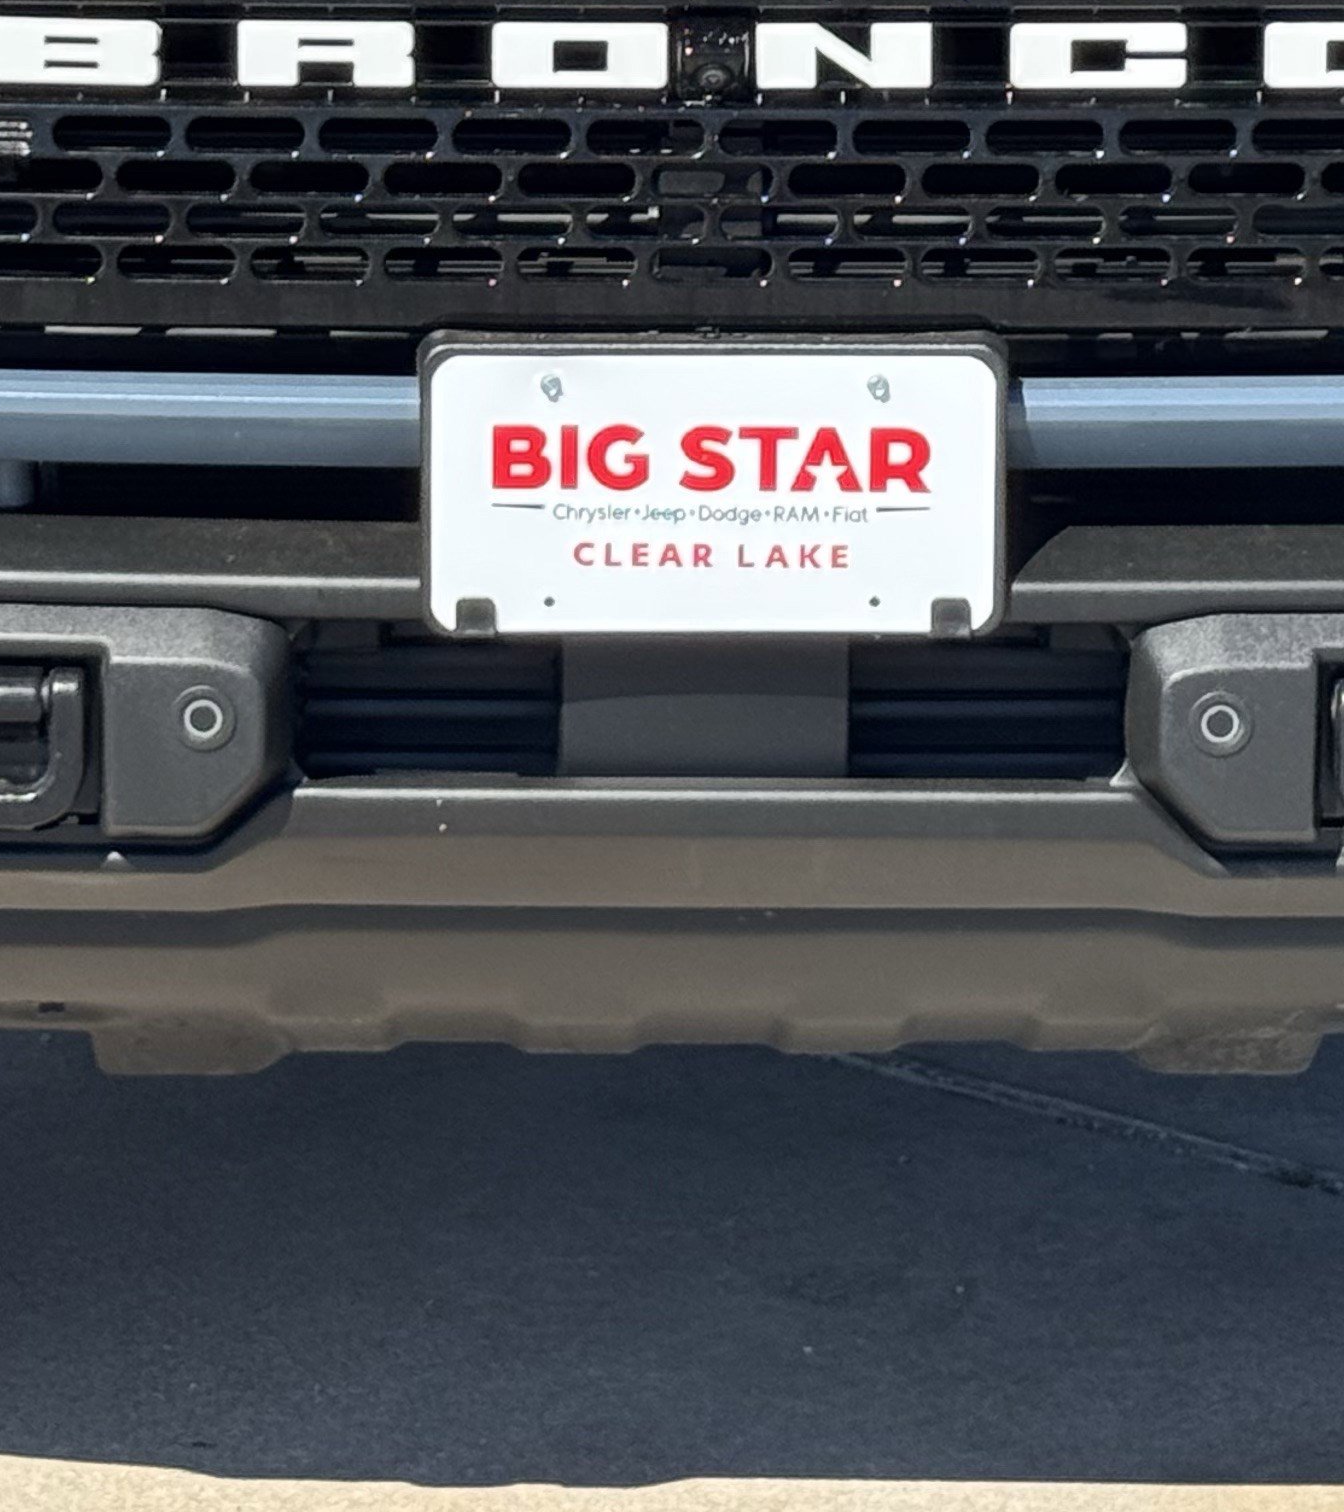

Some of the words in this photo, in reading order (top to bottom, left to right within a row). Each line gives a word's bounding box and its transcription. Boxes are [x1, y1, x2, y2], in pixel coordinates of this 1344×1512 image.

[491, 423, 650, 491] BIG
[679, 424, 931, 493] STAR
[552, 502, 631, 524] Chrysler
[641, 504, 687, 525] Jeep
[698, 504, 762, 526] Dodge
[773, 505, 820, 522] RAM
[832, 506, 869, 523] Fiat
[573, 542, 713, 568] CLEAR
[738, 544, 850, 569] LAKE
